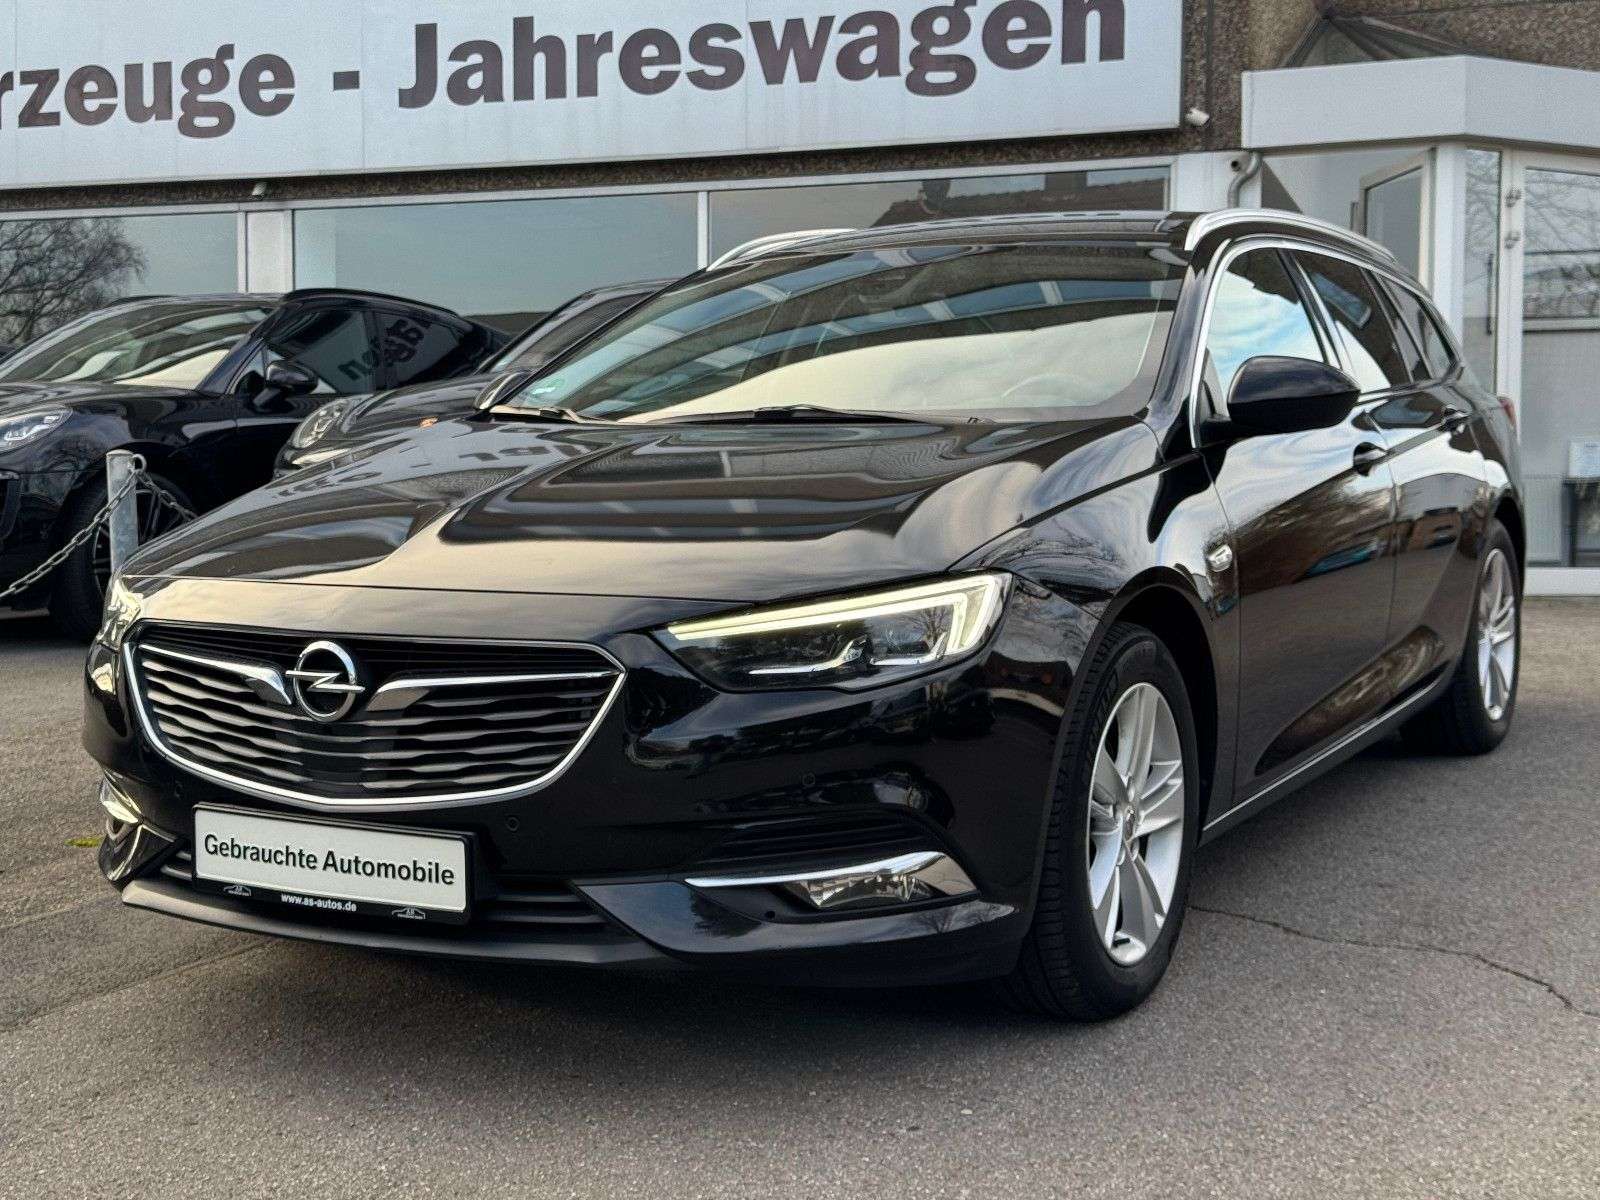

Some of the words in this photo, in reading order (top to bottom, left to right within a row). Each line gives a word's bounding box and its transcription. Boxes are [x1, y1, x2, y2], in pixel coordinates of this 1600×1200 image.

[333, 71, 360, 91] -
[399, 0, 1125, 108] Jahreswagen
[204, 833, 318, 870] Gebrauchte
[322, 850, 455, 886] Automobile
[280, 893, 358, 912] www.as-autos.de
